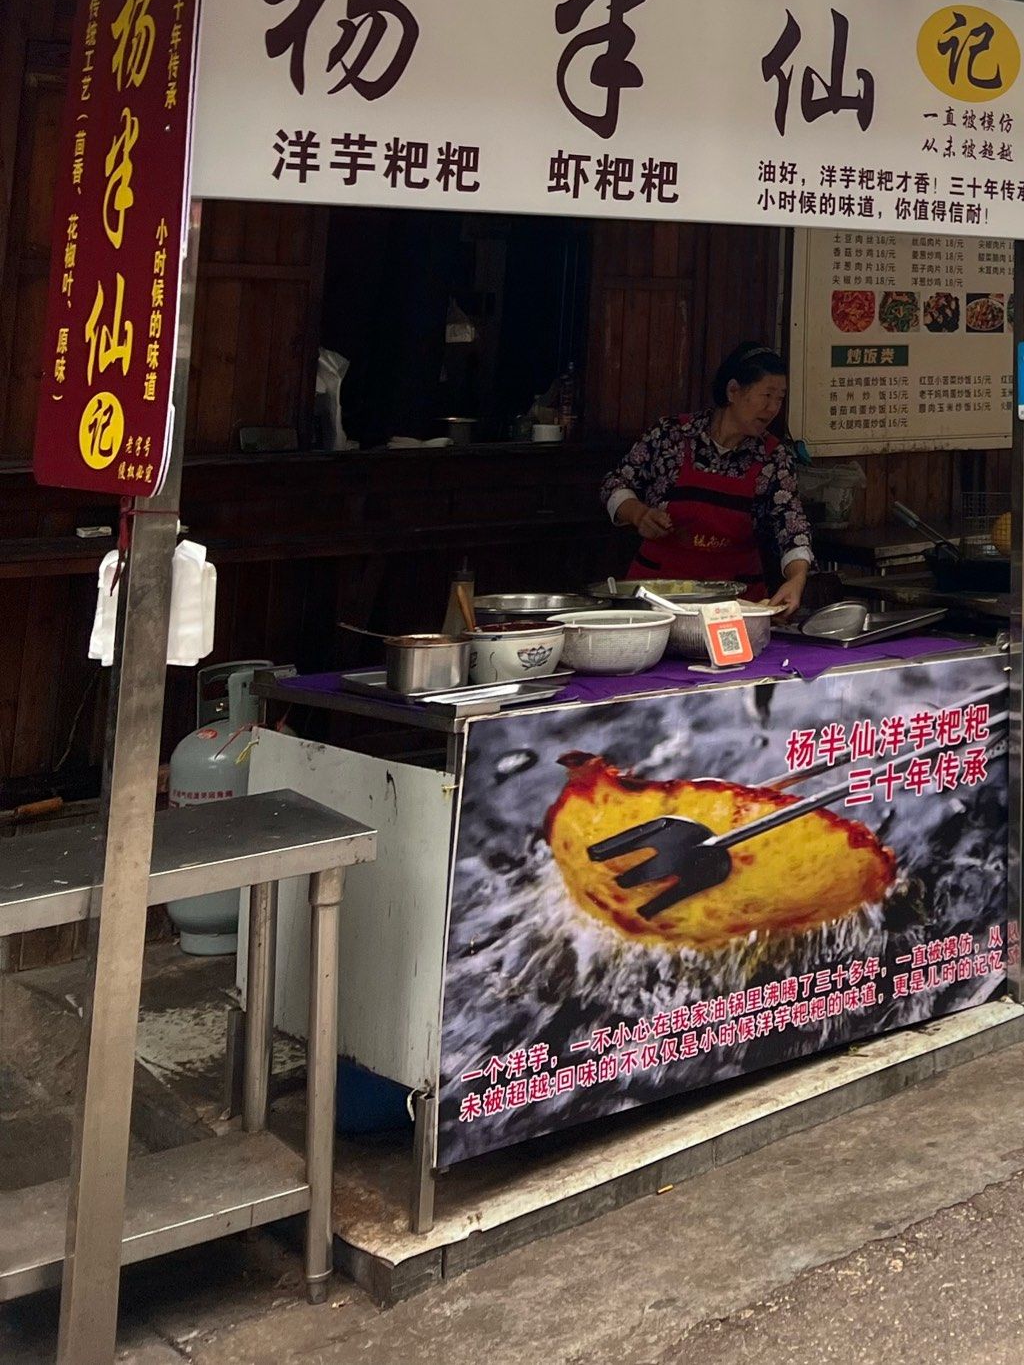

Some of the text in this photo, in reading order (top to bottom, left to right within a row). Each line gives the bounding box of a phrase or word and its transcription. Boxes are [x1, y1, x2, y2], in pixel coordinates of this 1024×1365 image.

[937, 10, 1003, 89] 记
[921, 135, 1015, 162] 从未被超越
[922, 106, 1014, 133] 一直被模仿
[271, 129, 680, 204] 洋芋粑粑 虾粑粑
[757, 188, 990, 225] 小时候的味道，你值得信耐！
[142, 217, 168, 402] 小时候的味道
[846, 347, 895, 365] 炒饭类
[88, 399, 114, 458] 记
[785, 703, 990, 772] 杨半仙洋芋粑粑
[844, 746, 988, 807] 三十年传承
